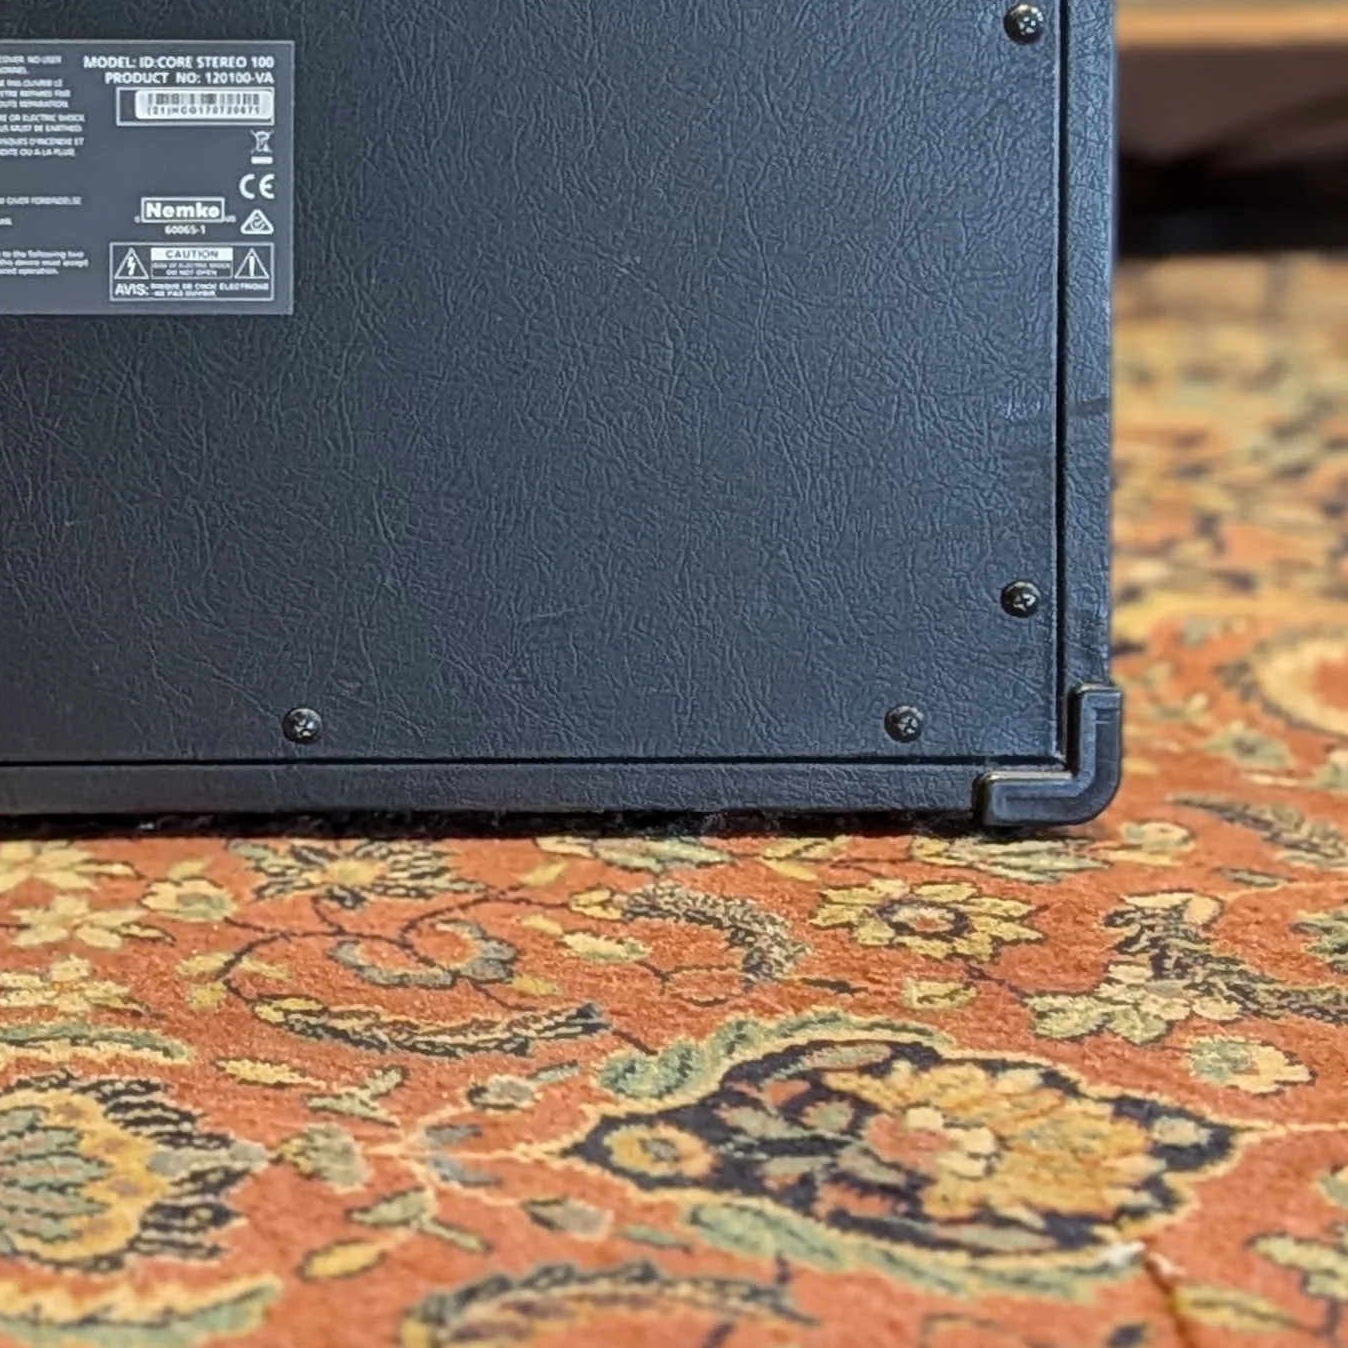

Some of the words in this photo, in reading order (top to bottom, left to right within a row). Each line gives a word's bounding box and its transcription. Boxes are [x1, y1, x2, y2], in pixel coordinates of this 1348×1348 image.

[83, 56, 136, 69] MODEL:
[139, 56, 193, 68] ID:CORE
[196, 56, 248, 68] STEREO
[251, 55, 274, 68] 100
[105, 72, 170, 85] PRODUCT
[176, 71, 202, 85] NO:
[205, 71, 274, 84] 120100-VA
[146, 201, 221, 219] Nemko
[165, 249, 219, 260] CAUTION
[114, 283, 150, 297] AVIS:
